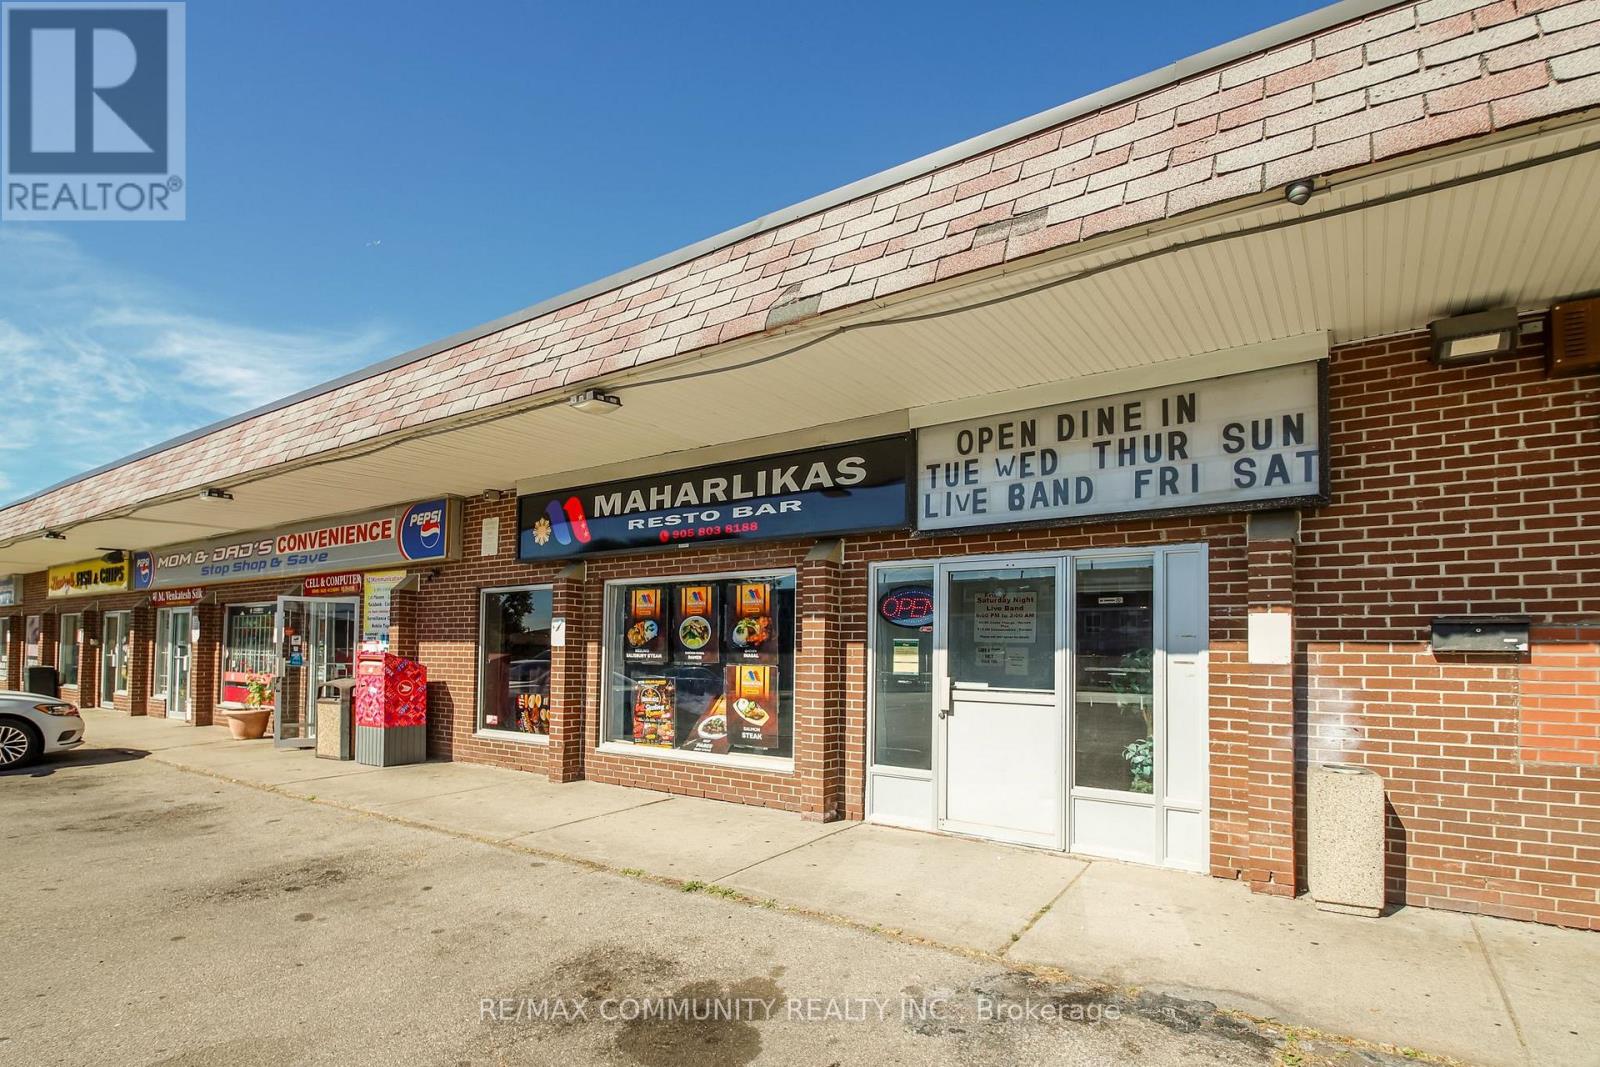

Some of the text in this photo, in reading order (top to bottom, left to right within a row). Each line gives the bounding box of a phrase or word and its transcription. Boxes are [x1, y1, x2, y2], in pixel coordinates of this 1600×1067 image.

[957, 392, 1196, 455] OPEN DINE IN
[926, 412, 1305, 489] TUE WED THUR SUN
[593, 456, 867, 518] MAHARLIKAS
[924, 450, 1320, 519] LIVE BAND FRI SAT
[410, 509, 442, 527] PEPSI
[627, 500, 802, 530] RESTO BAR
[157, 519, 393, 569] MOM & DAD'S CONVENIENCE
[672, 529, 695, 539] 905
[698, 526, 721, 537] 803
[76, 570, 92, 587] FISH
[100, 566, 125, 584] CHIPS
[201, 552, 329, 577] Stop Shop & Save
[305, 578, 320, 589] CELL
[320, 577, 326, 587] &
[326, 573, 362, 587] COMPUTER
[1013, 596, 1034, 604] Night
[741, 732, 763, 741] STEAK
